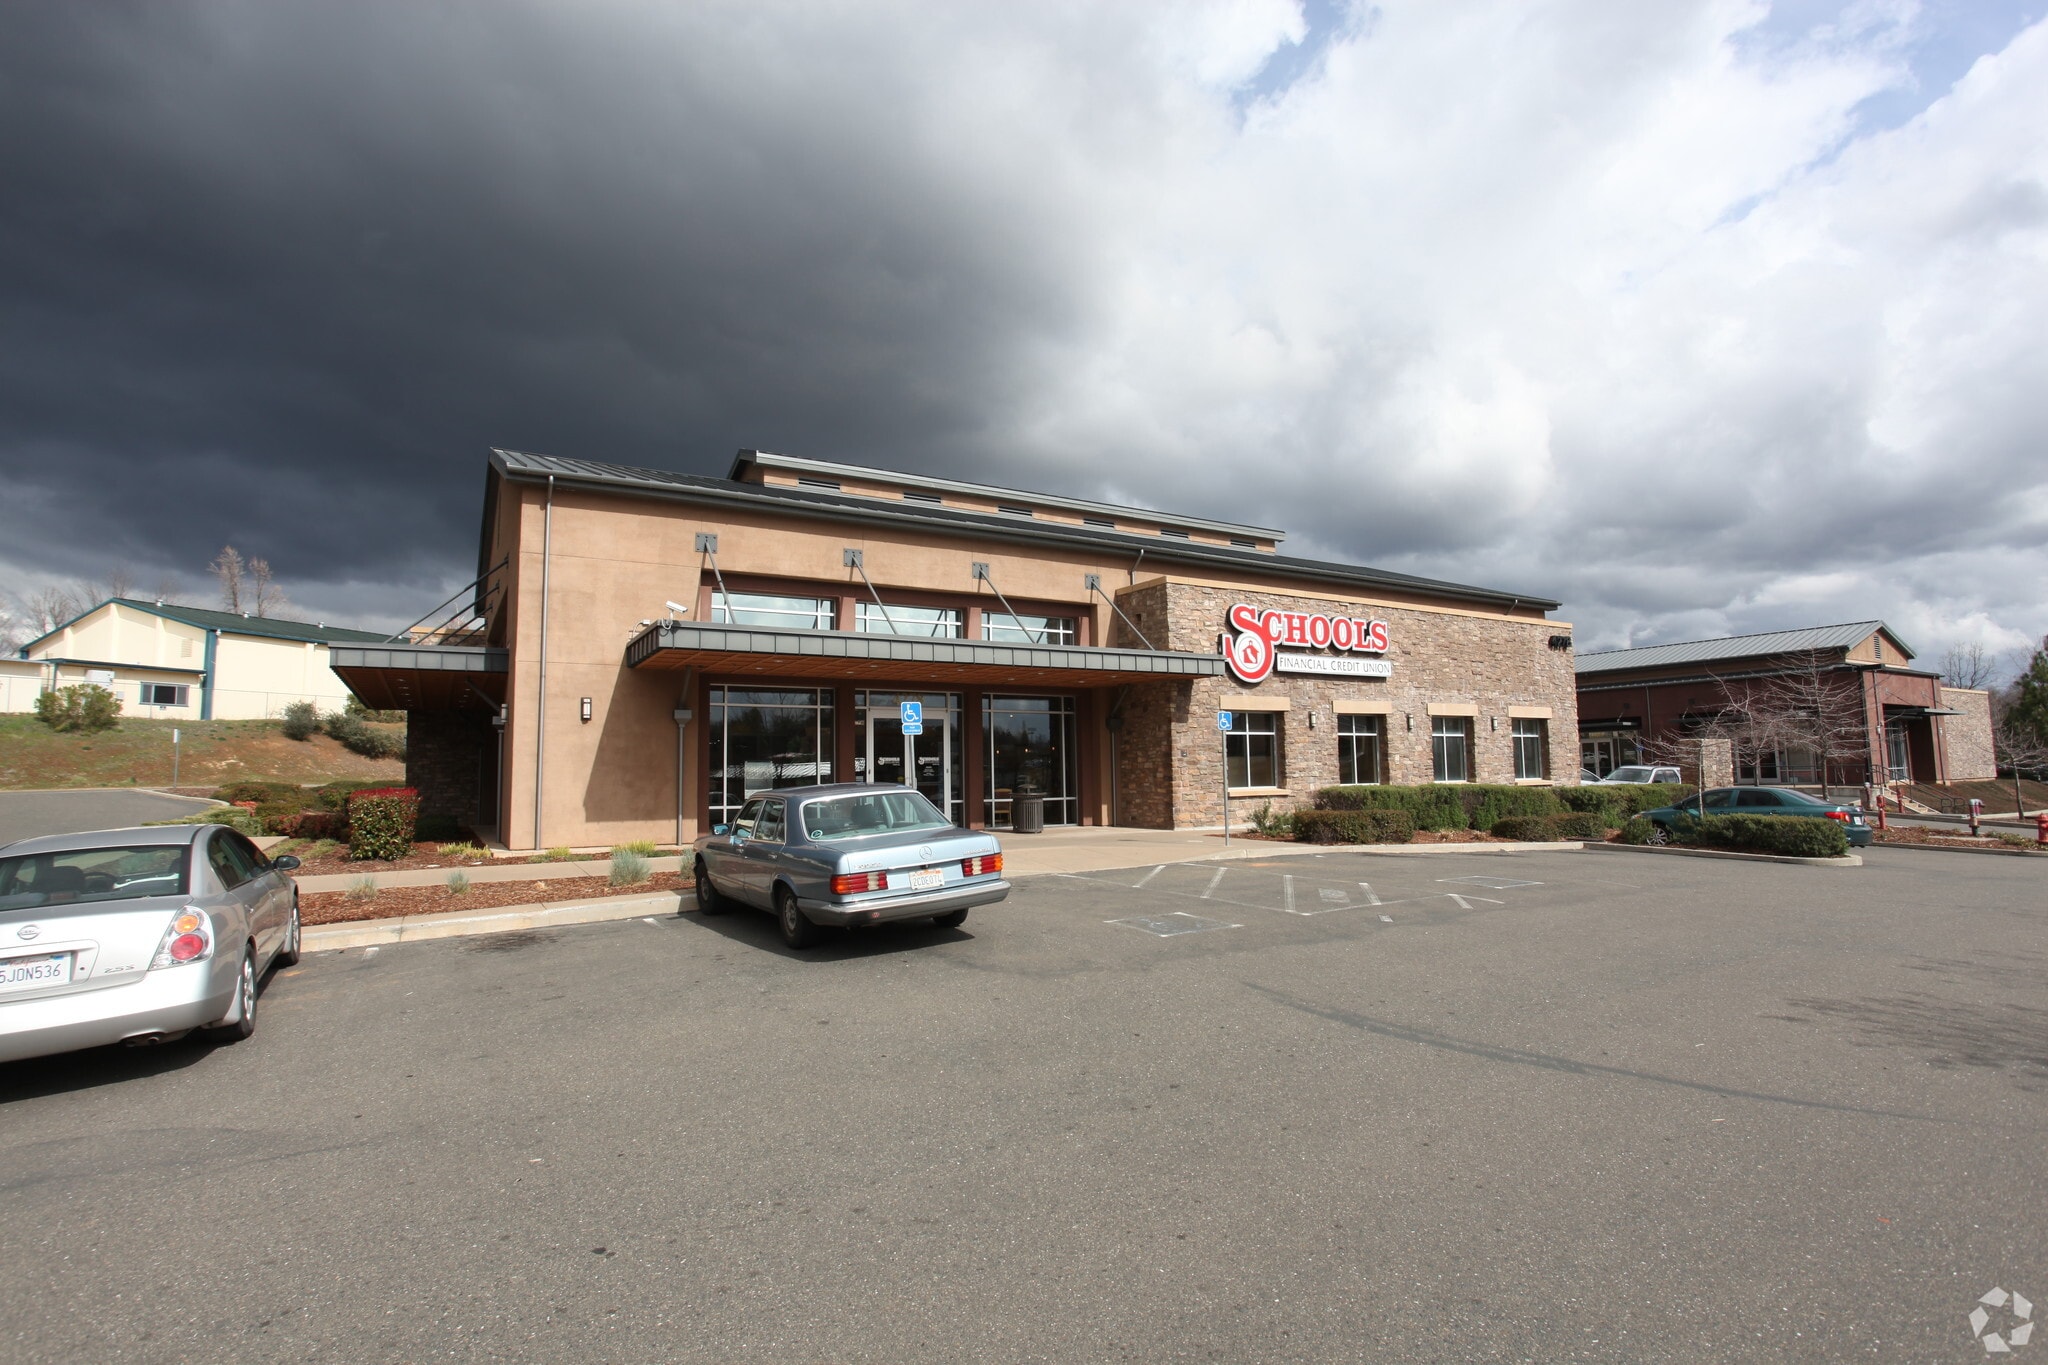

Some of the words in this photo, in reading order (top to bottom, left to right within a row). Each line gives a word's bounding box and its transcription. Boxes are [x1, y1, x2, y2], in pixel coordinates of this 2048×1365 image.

[1223, 604, 1389, 682] SCHOOLS
[1279, 656, 1328, 671] FINANCIAL
[1330, 660, 1360, 672] CREDIT
[1362, 662, 1390, 673] UNION
